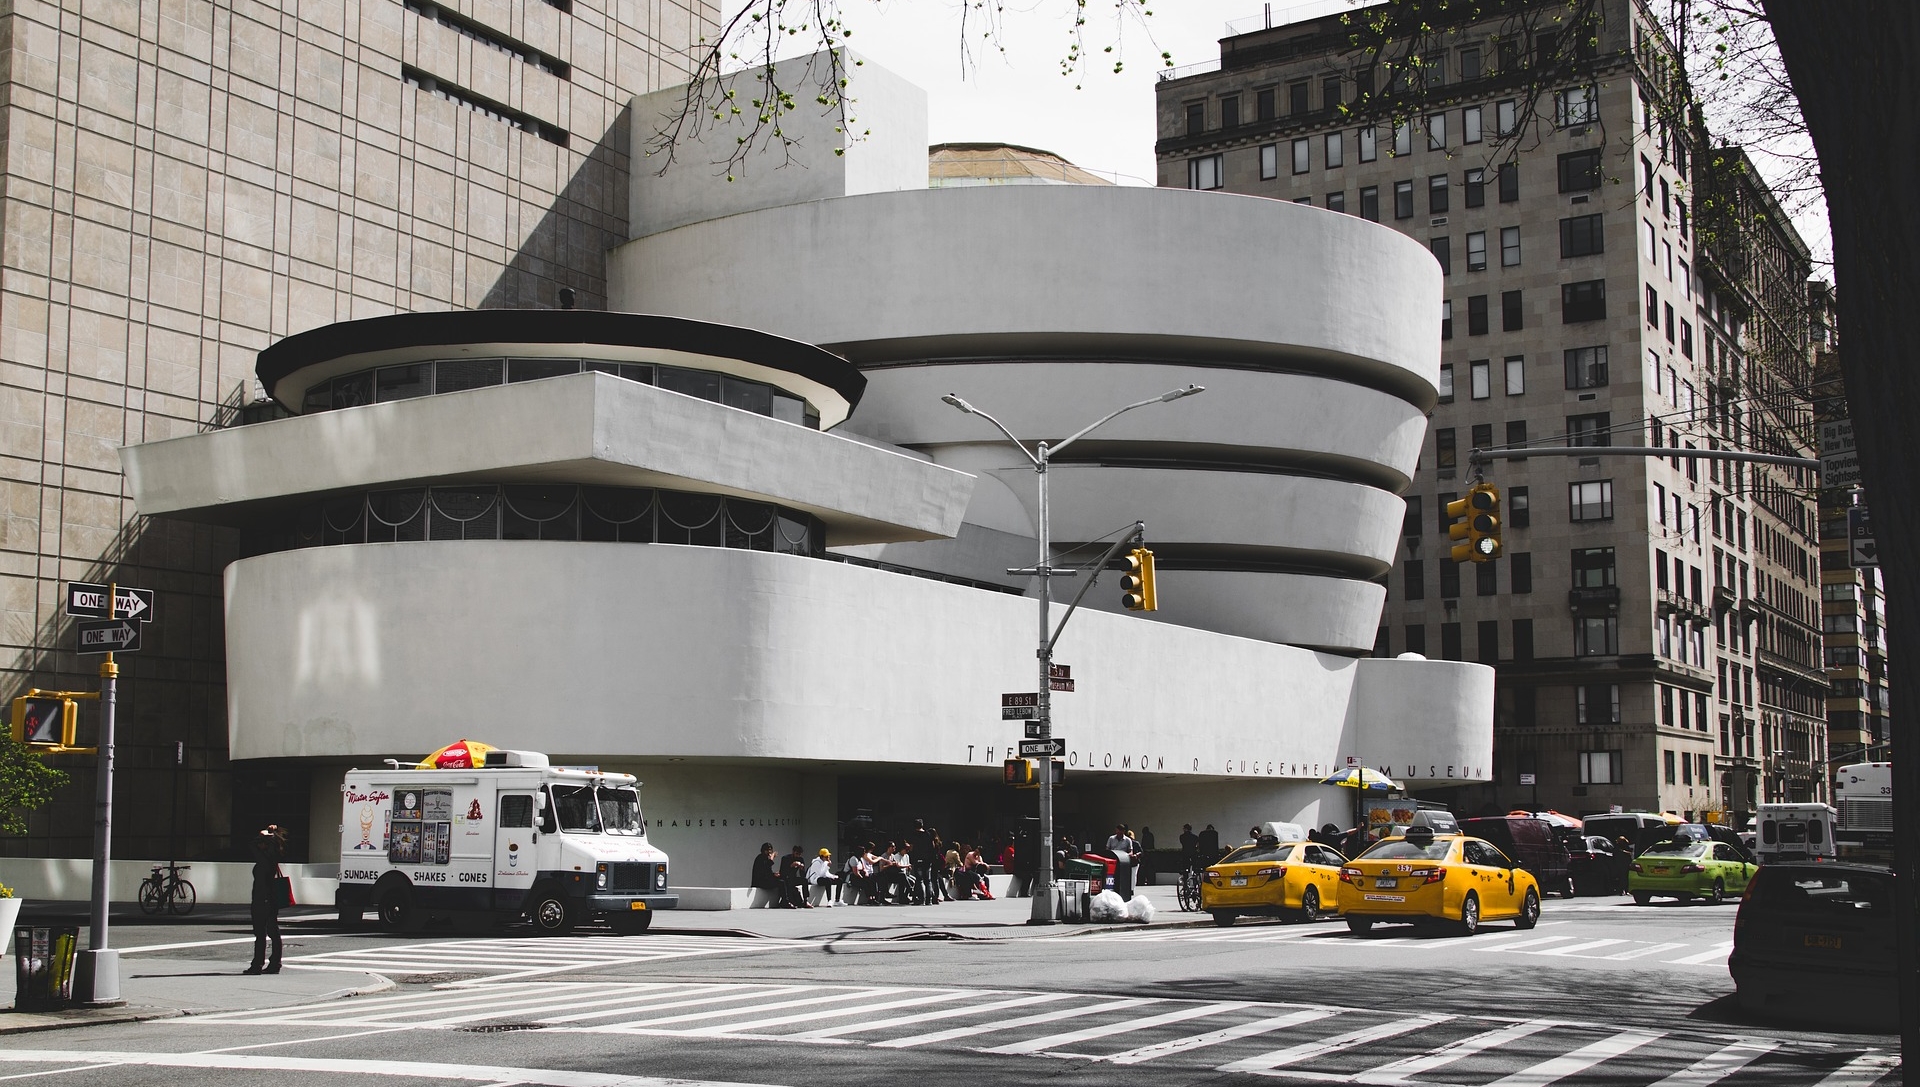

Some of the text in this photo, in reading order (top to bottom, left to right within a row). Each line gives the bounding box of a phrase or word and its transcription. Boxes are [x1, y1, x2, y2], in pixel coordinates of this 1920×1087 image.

[1824, 424, 1852, 439] Big Bus
[1824, 440, 1840, 452] New
[80, 593, 140, 611] ONE WAY
[86, 628, 131, 643] ONE WAY
[1008, 696, 1032, 705] E 89 St
[1002, 707, 1032, 716] FRED LEBOW
[1025, 744, 1057, 753] ONE WAY
[1069, 751, 1163, 770] OLOMON
[1379, 765, 1482, 778] MUSEUM
[1880, 786, 1891, 795] 33
[345, 791, 368, 804] Mister
[369, 791, 389, 805] Softee
[1397, 864, 1413, 872] 357
[344, 869, 487, 883] SUNDAES SHAKES CONES
